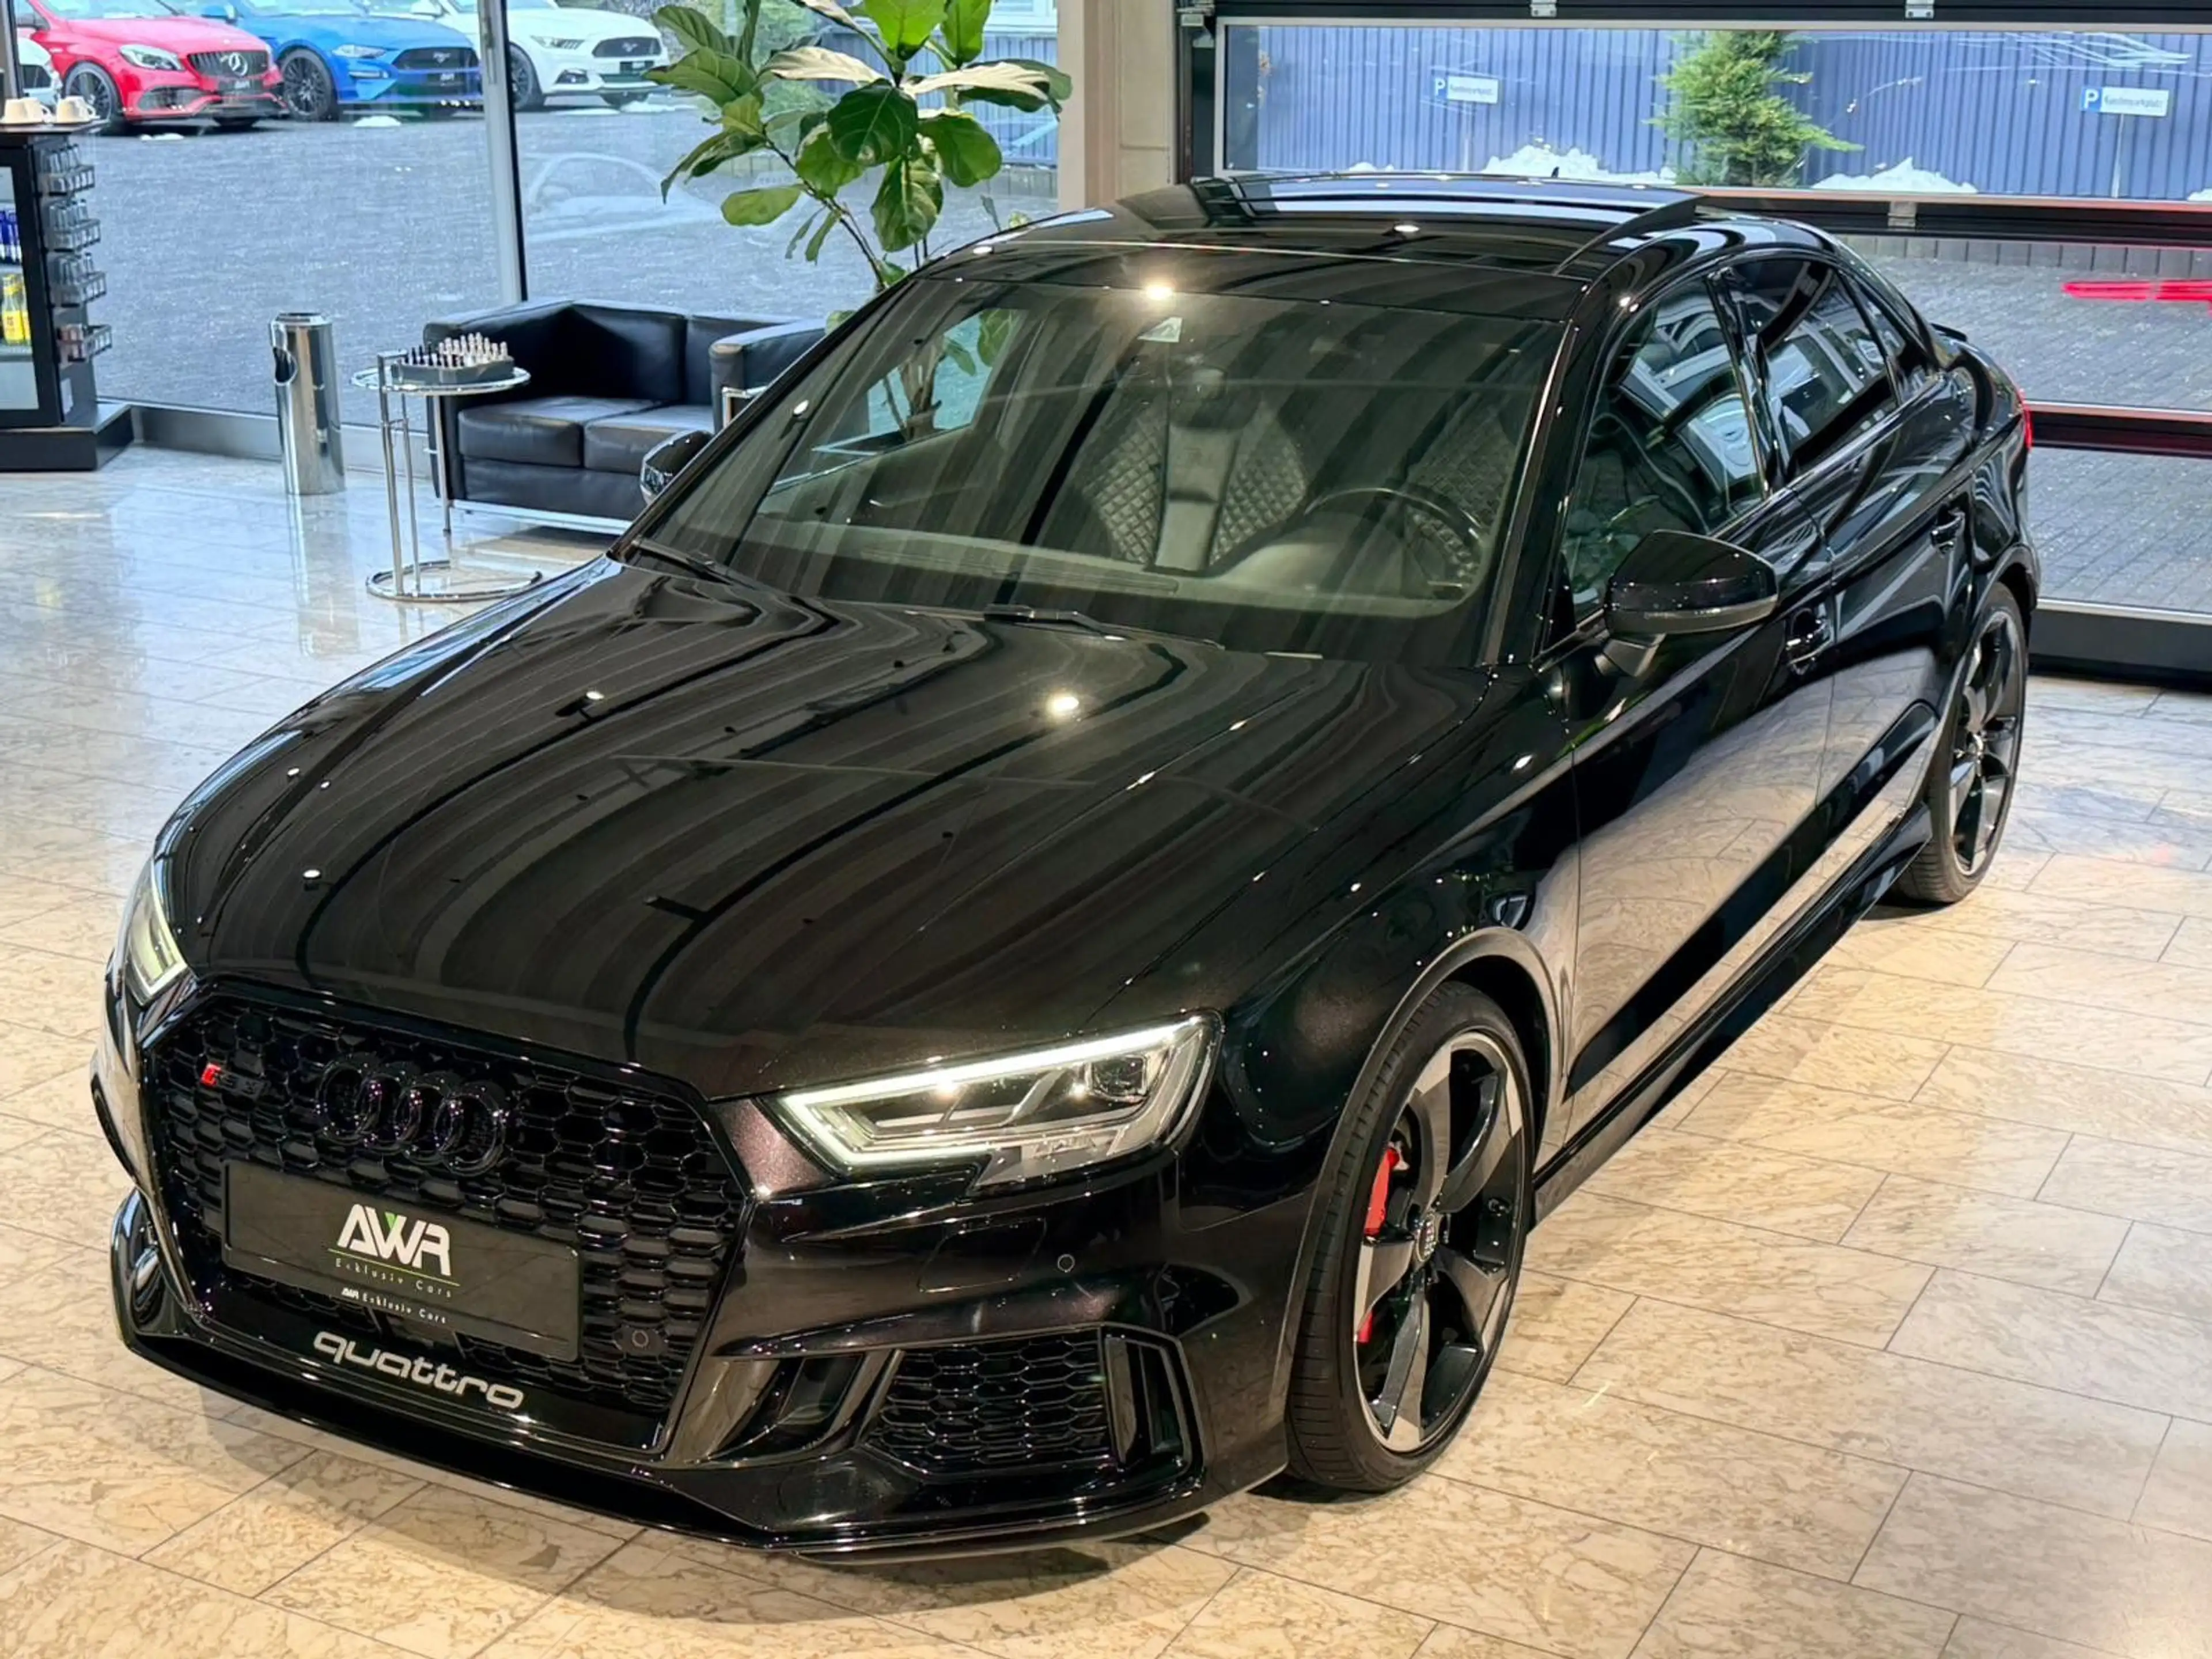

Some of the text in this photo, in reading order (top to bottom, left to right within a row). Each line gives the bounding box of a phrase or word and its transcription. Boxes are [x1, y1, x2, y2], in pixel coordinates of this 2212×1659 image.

[1435, 78, 1446, 95] P
[2084, 89, 2099, 109] P
[337, 1204, 450, 1277] AWR
[313, 1331, 524, 1409] quattro
